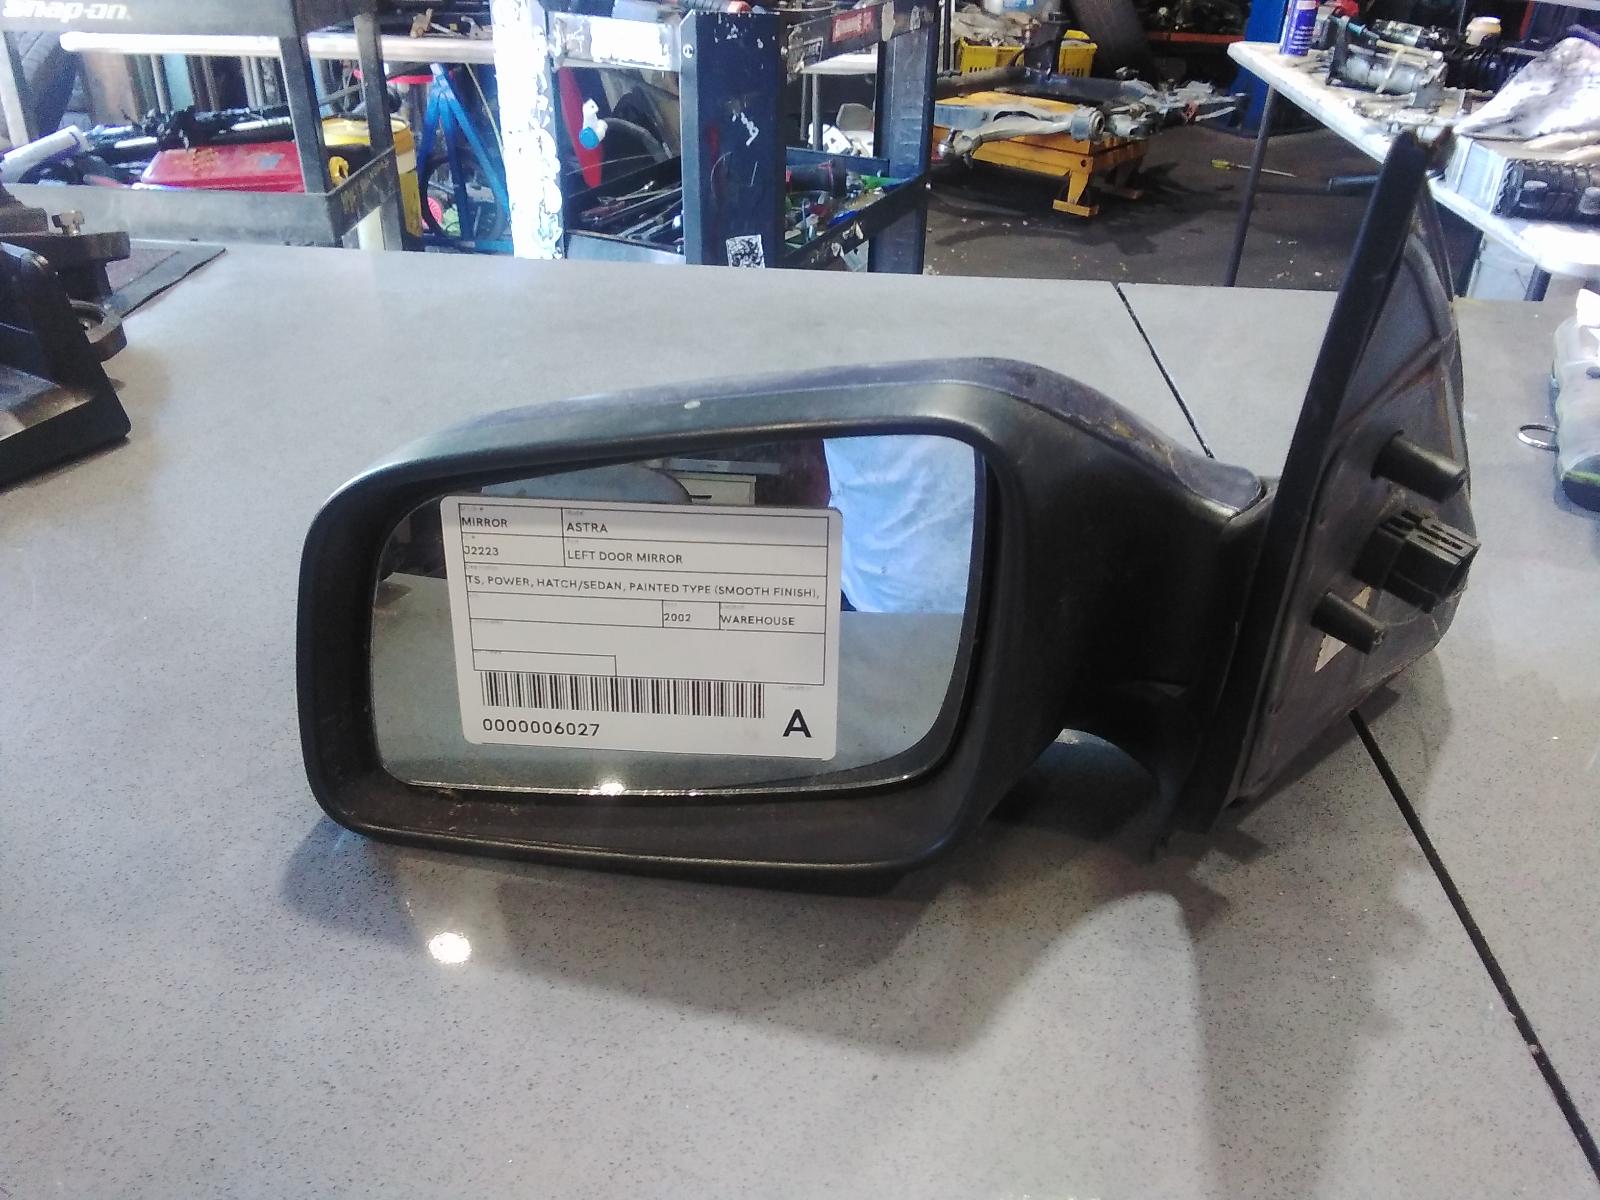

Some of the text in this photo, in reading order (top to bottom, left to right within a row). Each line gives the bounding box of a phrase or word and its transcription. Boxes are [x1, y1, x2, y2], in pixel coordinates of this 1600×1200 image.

[461, 517, 508, 528] MIRROR
[566, 522, 608, 533] ASTRA
[567, 550, 683, 564] LEFT DOOR MIRROR
[487, 576, 534, 588] POWER,
[537, 578, 626, 592] HATCH/SEDAN,
[629, 582, 680, 593] PAINTED
[682, 584, 711, 594] TYPE
[714, 585, 770, 596] (SMOOTH
[663, 612, 692, 622] 2002
[719, 614, 796, 626] WAREHOUSE
[482, 718, 601, 737] 0000006027
[782, 709, 812, 738] A
